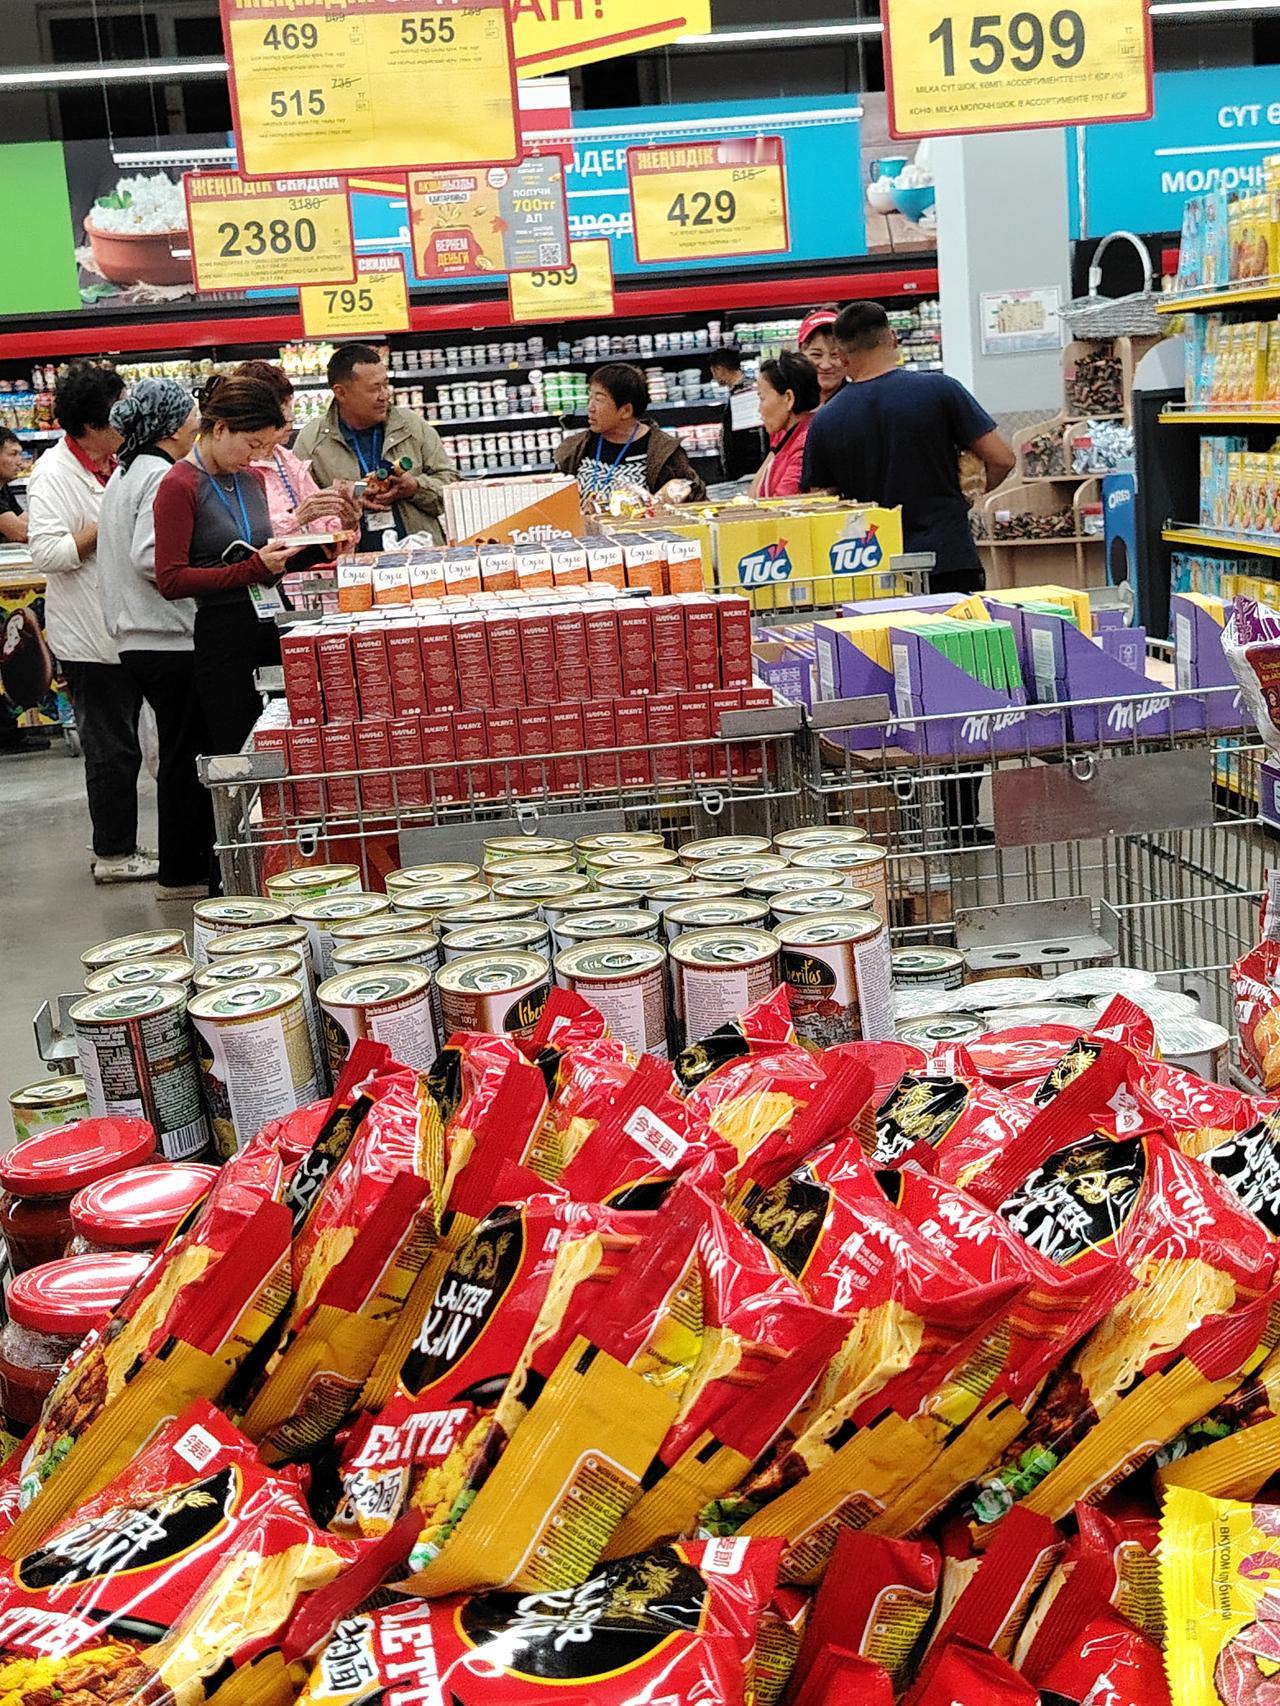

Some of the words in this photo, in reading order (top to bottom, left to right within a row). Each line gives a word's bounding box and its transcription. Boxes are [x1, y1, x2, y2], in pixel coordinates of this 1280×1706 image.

[263, 23, 318, 50] 469
[401, 17, 455, 45] 555
[928, 9, 1086, 77] 1599
[271, 89, 325, 117] 515
[1218, 104, 1262, 128] СҮТ
[637, 148, 714, 170] ЖЕҢІЛДІК
[513, 187, 552, 198] ПОЛУЧИ
[667, 190, 736, 226] 429
[218, 217, 316, 258] 2380
[323, 288, 373, 314] 795
[741, 555, 787, 584] TUC
[832, 541, 878, 571] TUC
[634, 1116, 678, 1159] 今麦郎
